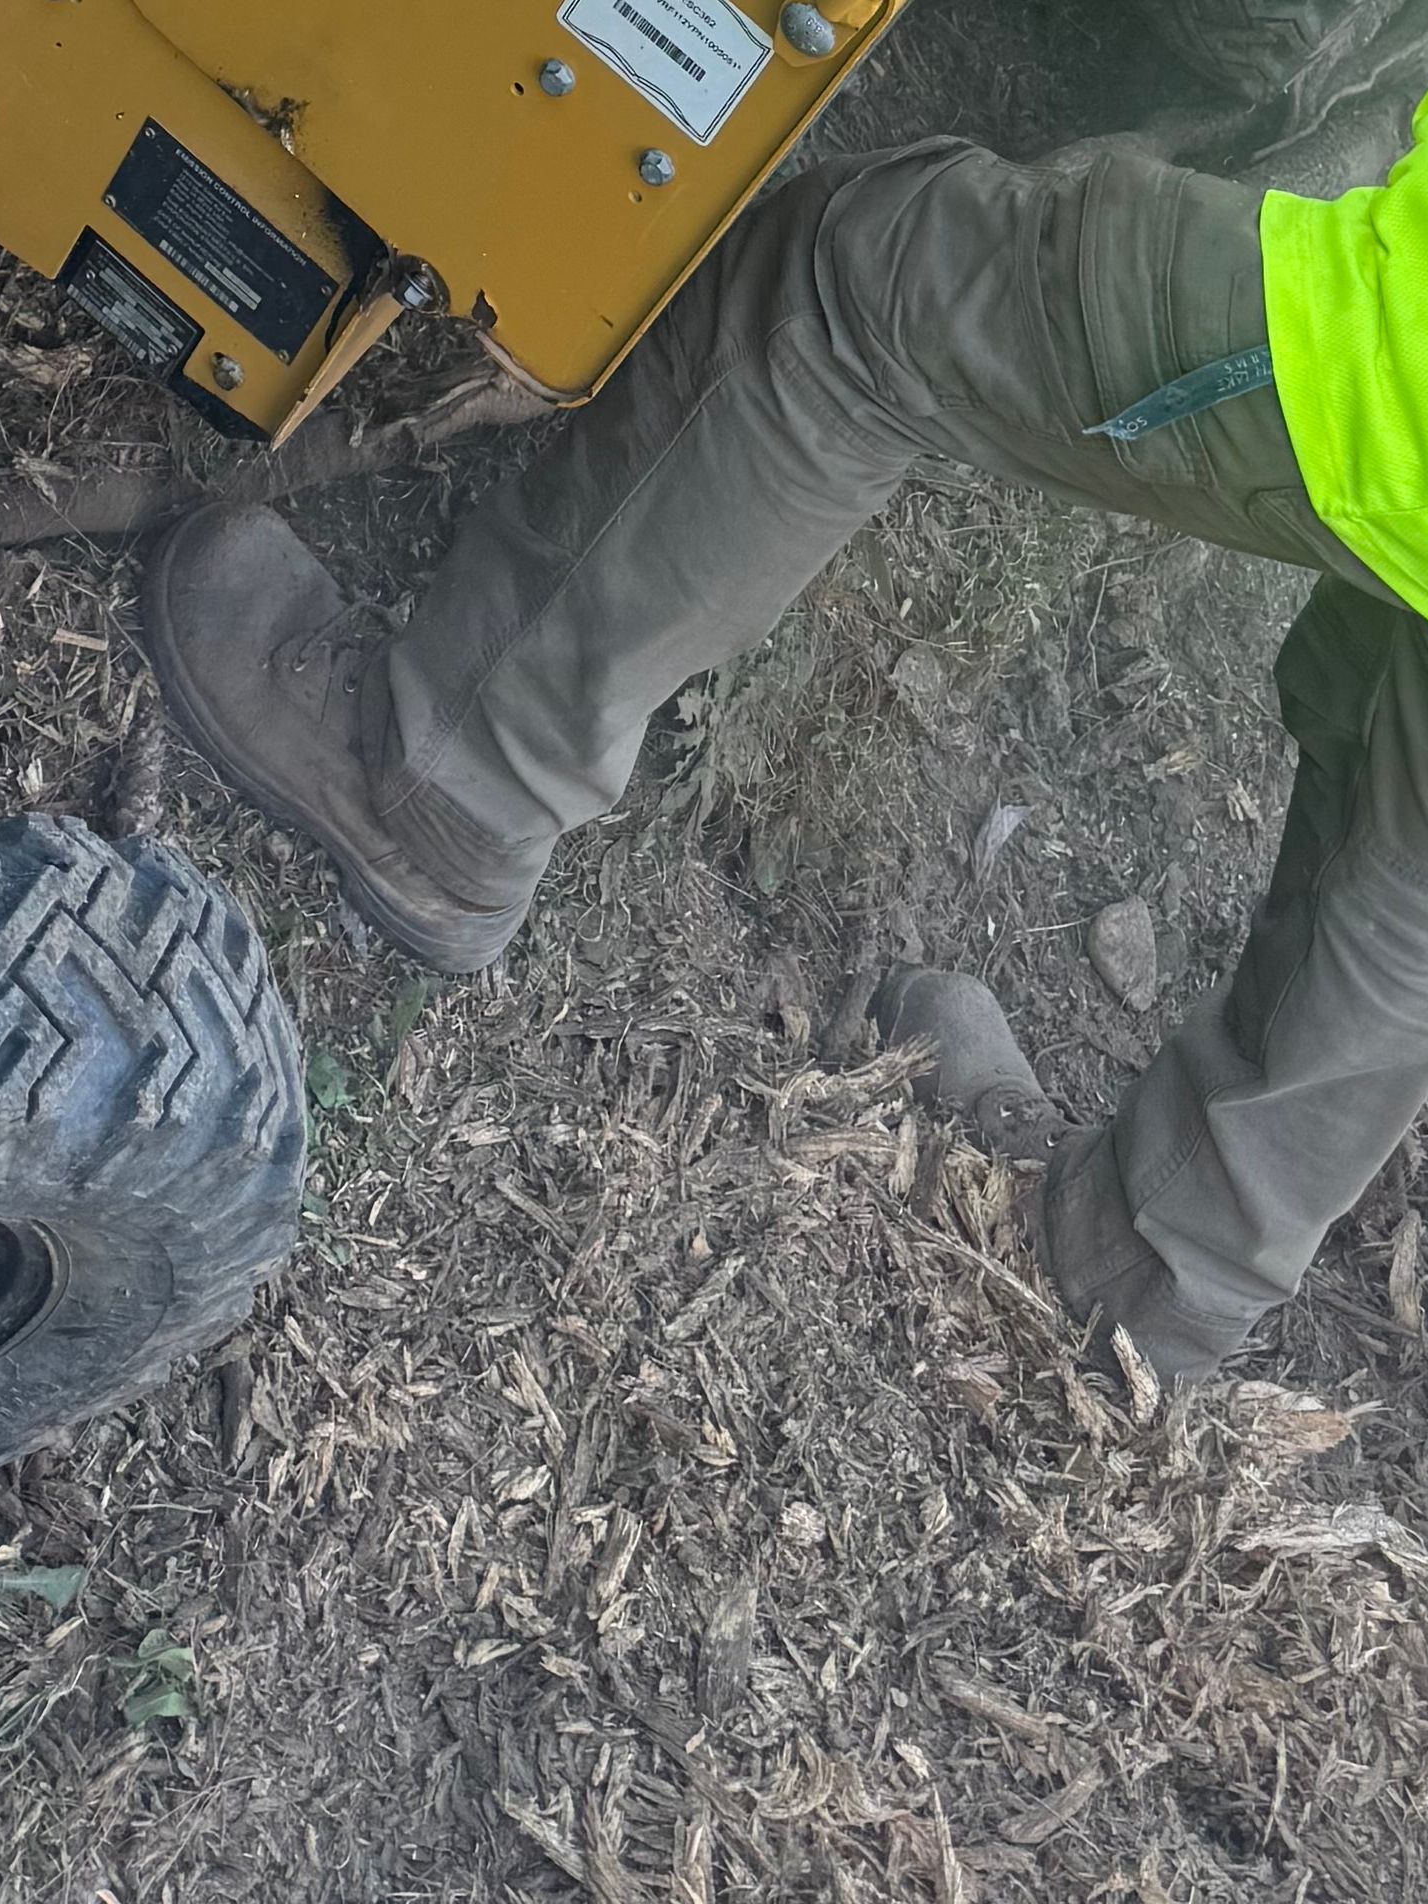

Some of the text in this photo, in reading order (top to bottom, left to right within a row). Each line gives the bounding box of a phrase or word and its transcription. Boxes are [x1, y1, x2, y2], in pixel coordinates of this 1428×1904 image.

[175, 147, 307, 268] EMISSION CONTROL INFORMATION
[1217, 371, 1249, 392] LAKE
